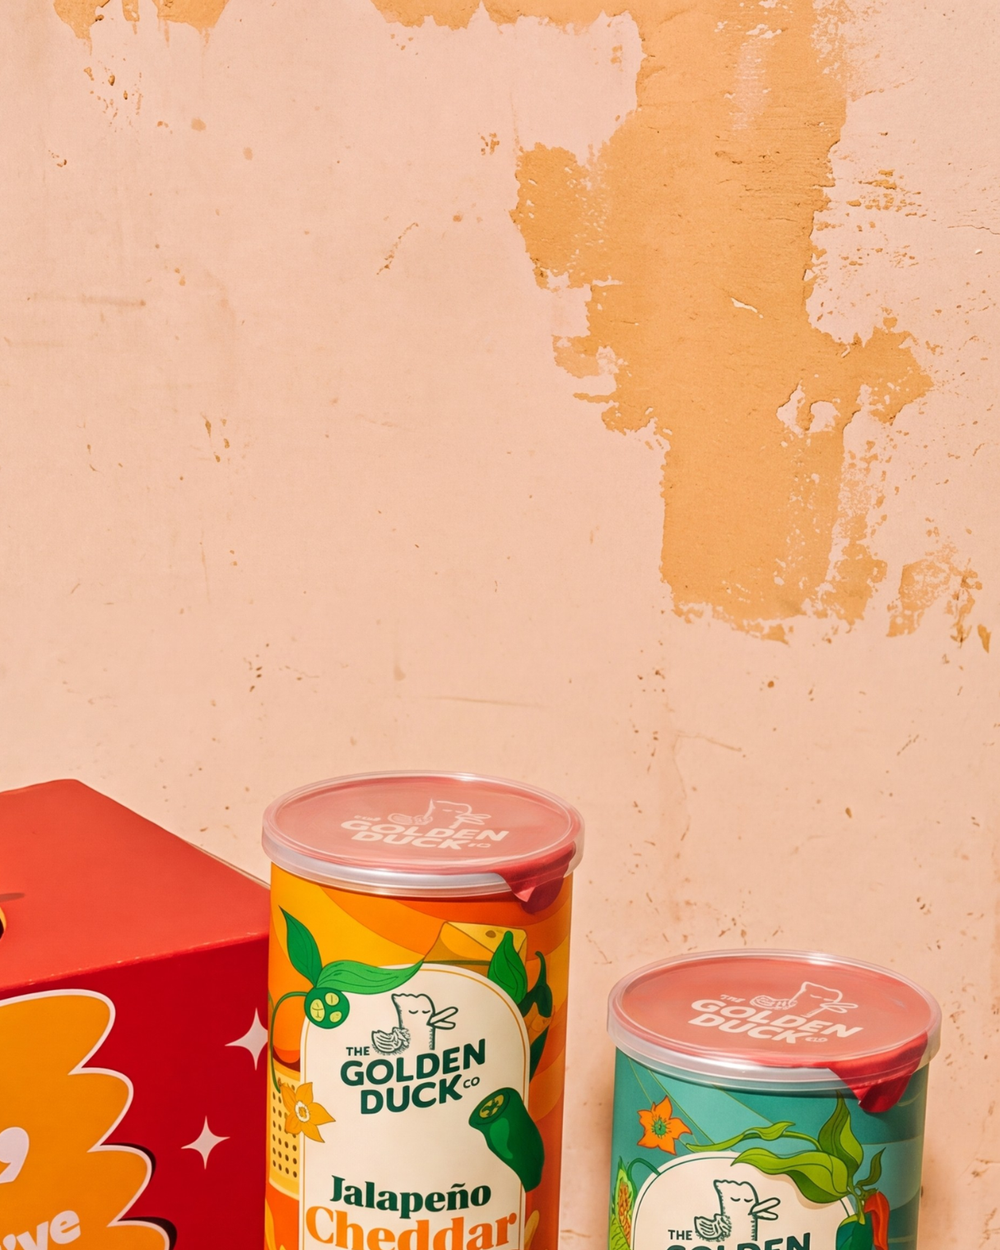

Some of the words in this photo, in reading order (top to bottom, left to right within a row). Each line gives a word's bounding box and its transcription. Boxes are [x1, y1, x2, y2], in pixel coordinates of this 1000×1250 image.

[340, 819, 509, 842] GOLDEN
[351, 831, 470, 850] DUCK
[687, 1013, 813, 1044] DUCK
[691, 999, 864, 1038] GOLDEN
[340, 1038, 486, 1087] GOLDEN
[346, 1046, 370, 1056] THE
[360, 1073, 463, 1115] DUCK
[462, 1076, 480, 1089] CO
[329, 1175, 492, 1219] Jalapeño
[667, 1229, 693, 1241] THE
